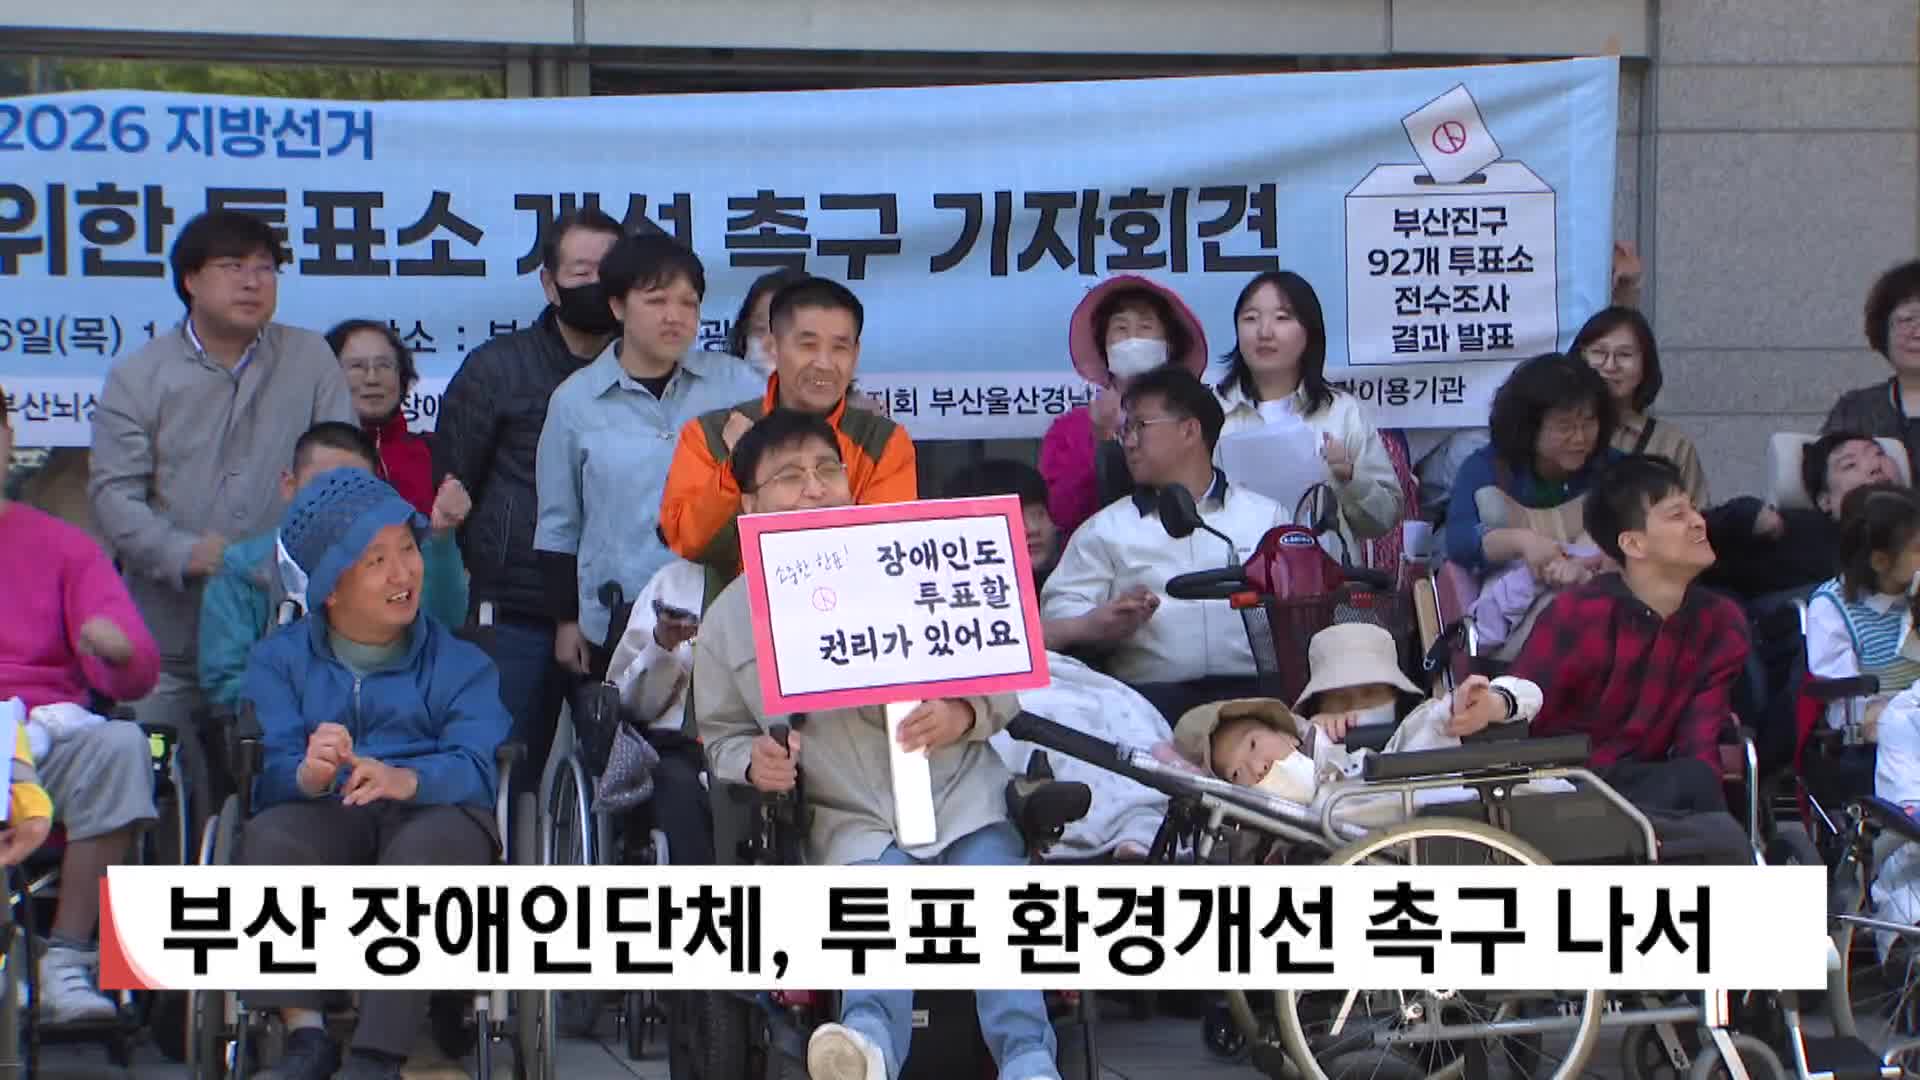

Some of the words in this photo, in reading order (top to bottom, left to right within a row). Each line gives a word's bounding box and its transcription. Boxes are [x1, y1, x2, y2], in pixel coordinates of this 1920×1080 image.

[0, 104, 149, 152] 2026
[167, 105, 374, 160] 지방선거
[0, 182, 174, 278] 위한
[725, 190, 901, 280] 촉구
[930, 184, 1280, 276] 기자회견
[1393, 206, 1508, 238] 부산진구
[1367, 246, 1440, 276] 92개
[1448, 244, 1534, 276] 투표소
[1394, 283, 1511, 316] 전수조사
[1392, 323, 1450, 353] 결과
[1457, 322, 1514, 352] 발표
[877, 536, 1005, 577] 장애인도
[914, 574, 1011, 616] 투표할
[820, 624, 914, 666] 권리가
[924, 617, 1021, 657] 있어요
